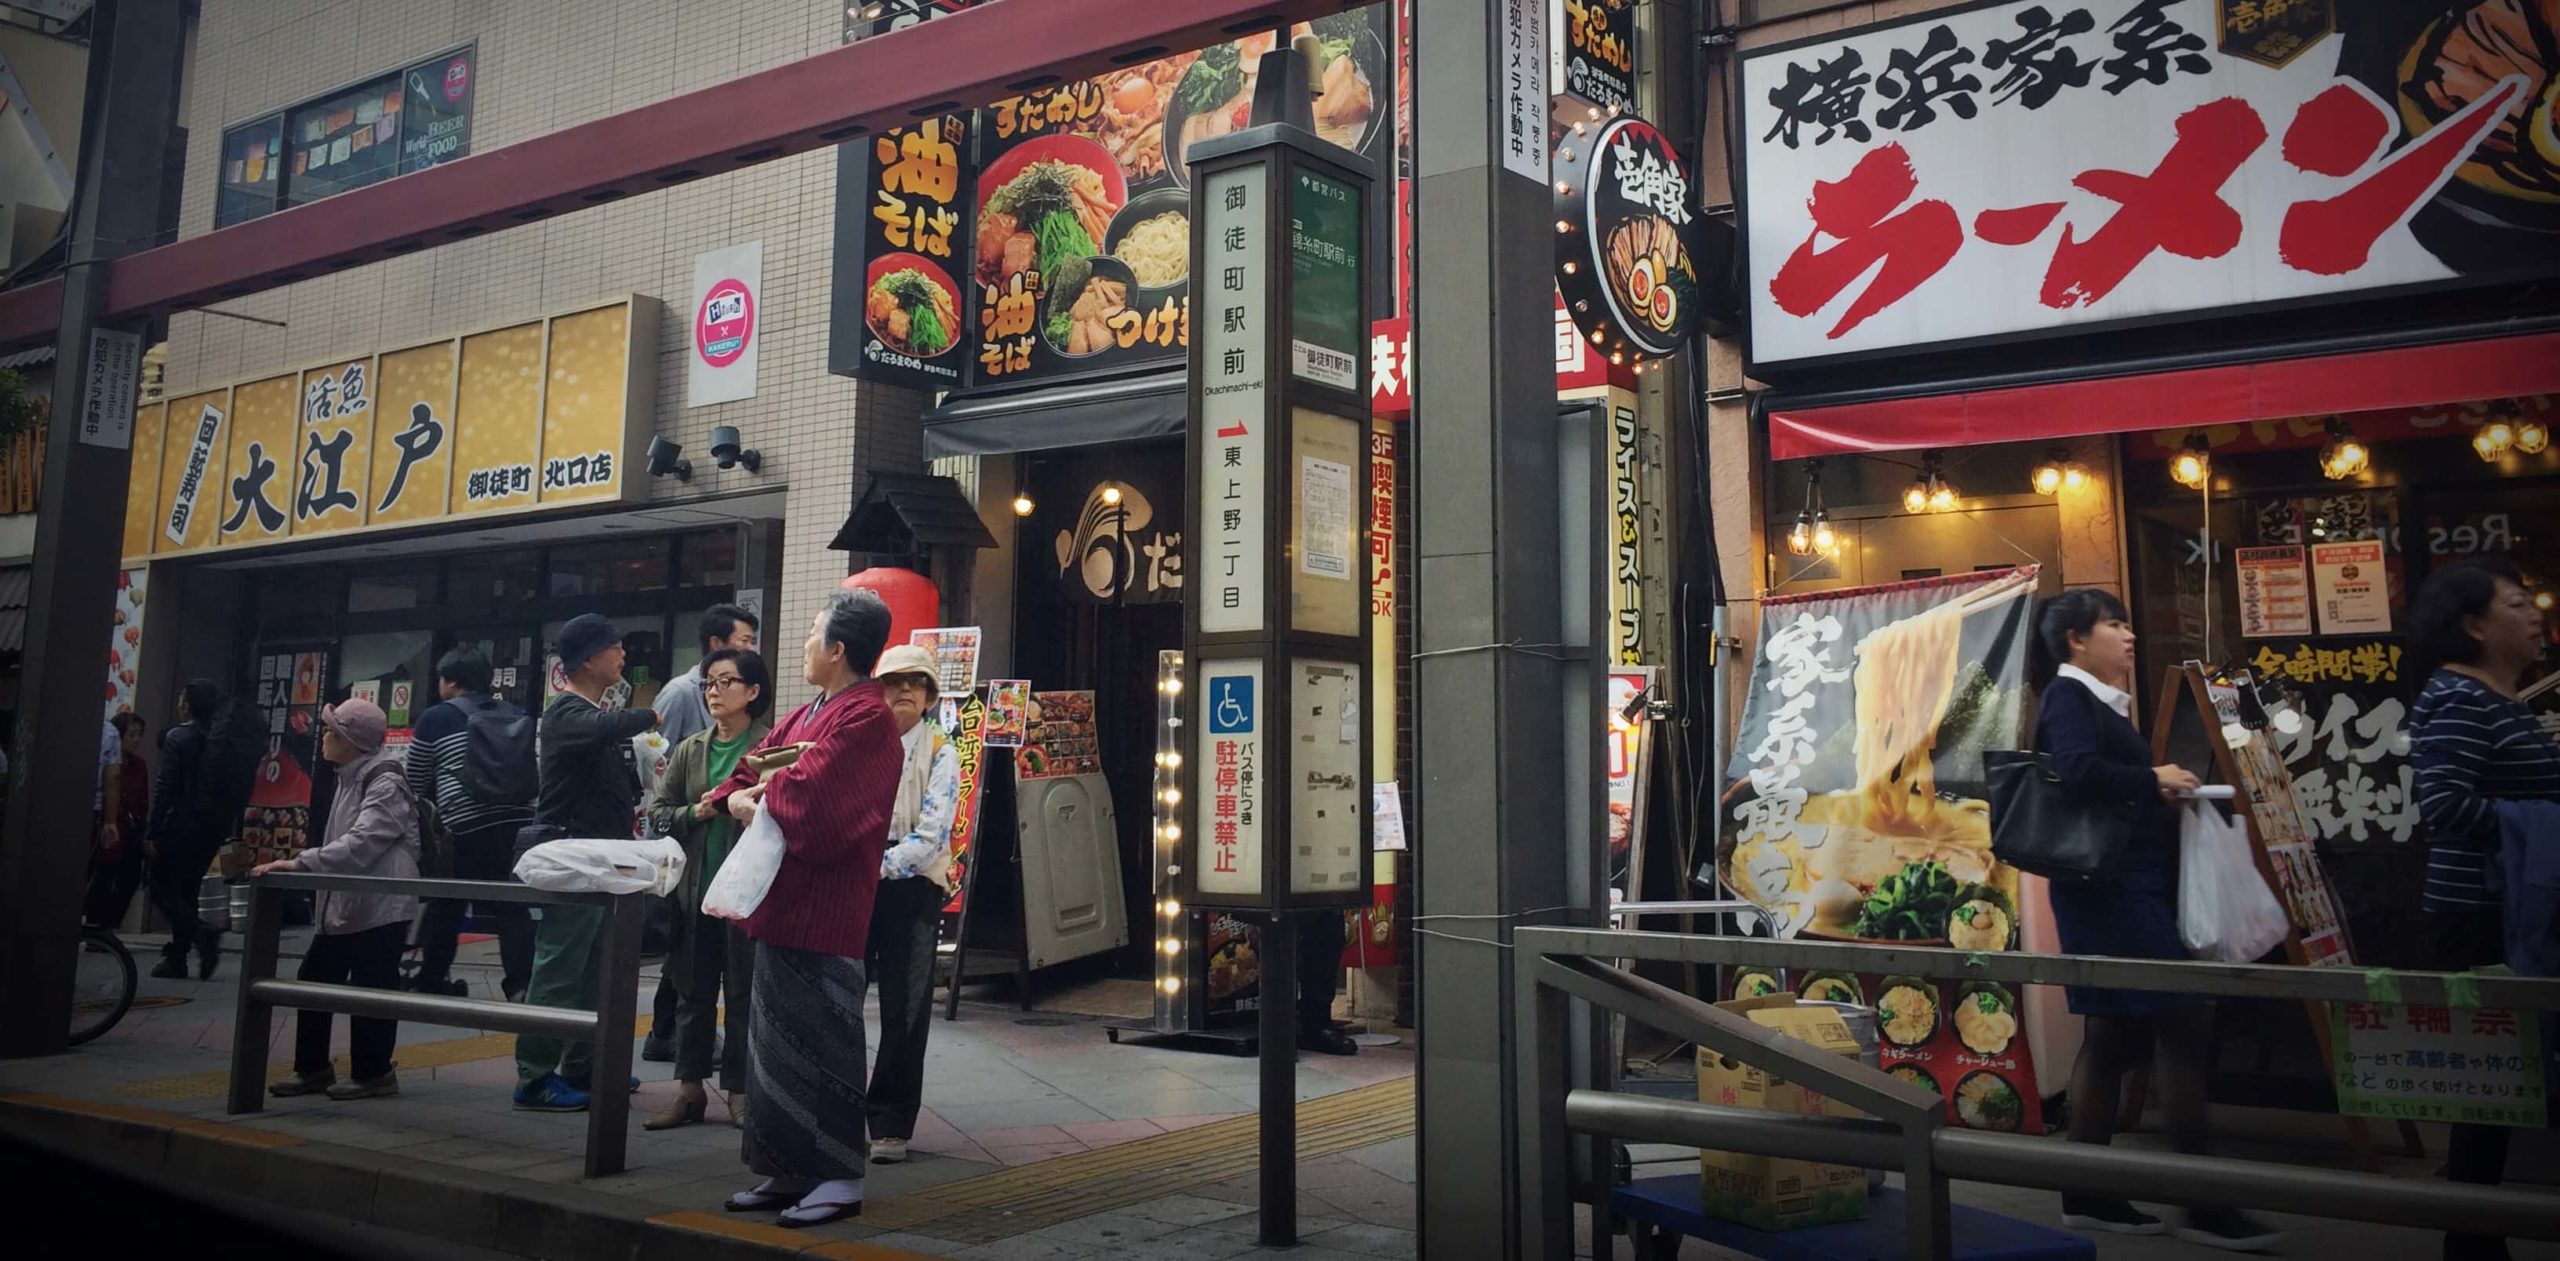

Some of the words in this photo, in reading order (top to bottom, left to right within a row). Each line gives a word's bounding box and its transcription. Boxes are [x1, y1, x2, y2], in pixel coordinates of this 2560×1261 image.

[1763, 0, 2212, 150] 横浜家系
[427, 114, 464, 137] BEER
[427, 135, 457, 158] FOOD
[877, 117, 958, 204] 油
[1311, 179, 1346, 202] 都営バス
[1613, 131, 1693, 225] 壱角家
[1768, 82, 2517, 340] ラーメン
[873, 190, 959, 258] そば
[982, 272, 1035, 342] 油
[1223, 184, 1247, 376] 御徒町駅前
[86, 336, 108, 437] 防犯カメラ作動中
[124, 341, 136, 381] Security
[306, 365, 367, 423] 活魚
[980, 335, 1036, 376] そば
[1307, 348, 1353, 375] 御徒町駅前
[171, 411, 218, 536] 回転寿司
[221, 402, 443, 532] 大江戸
[468, 465, 532, 500] 御徒町
[544, 452, 612, 489] 北口店
[1223, 446, 1242, 608] 東上野一丁目
[2252, 641, 2403, 684] 全時間帯!
[2263, 692, 2412, 767] ライス
[1213, 740, 1239, 873] 駐停車禁止
[1240, 742, 1254, 826] バス停につき
[1734, 611, 1857, 941] 家系最高
[2291, 762, 2422, 843] 無料
